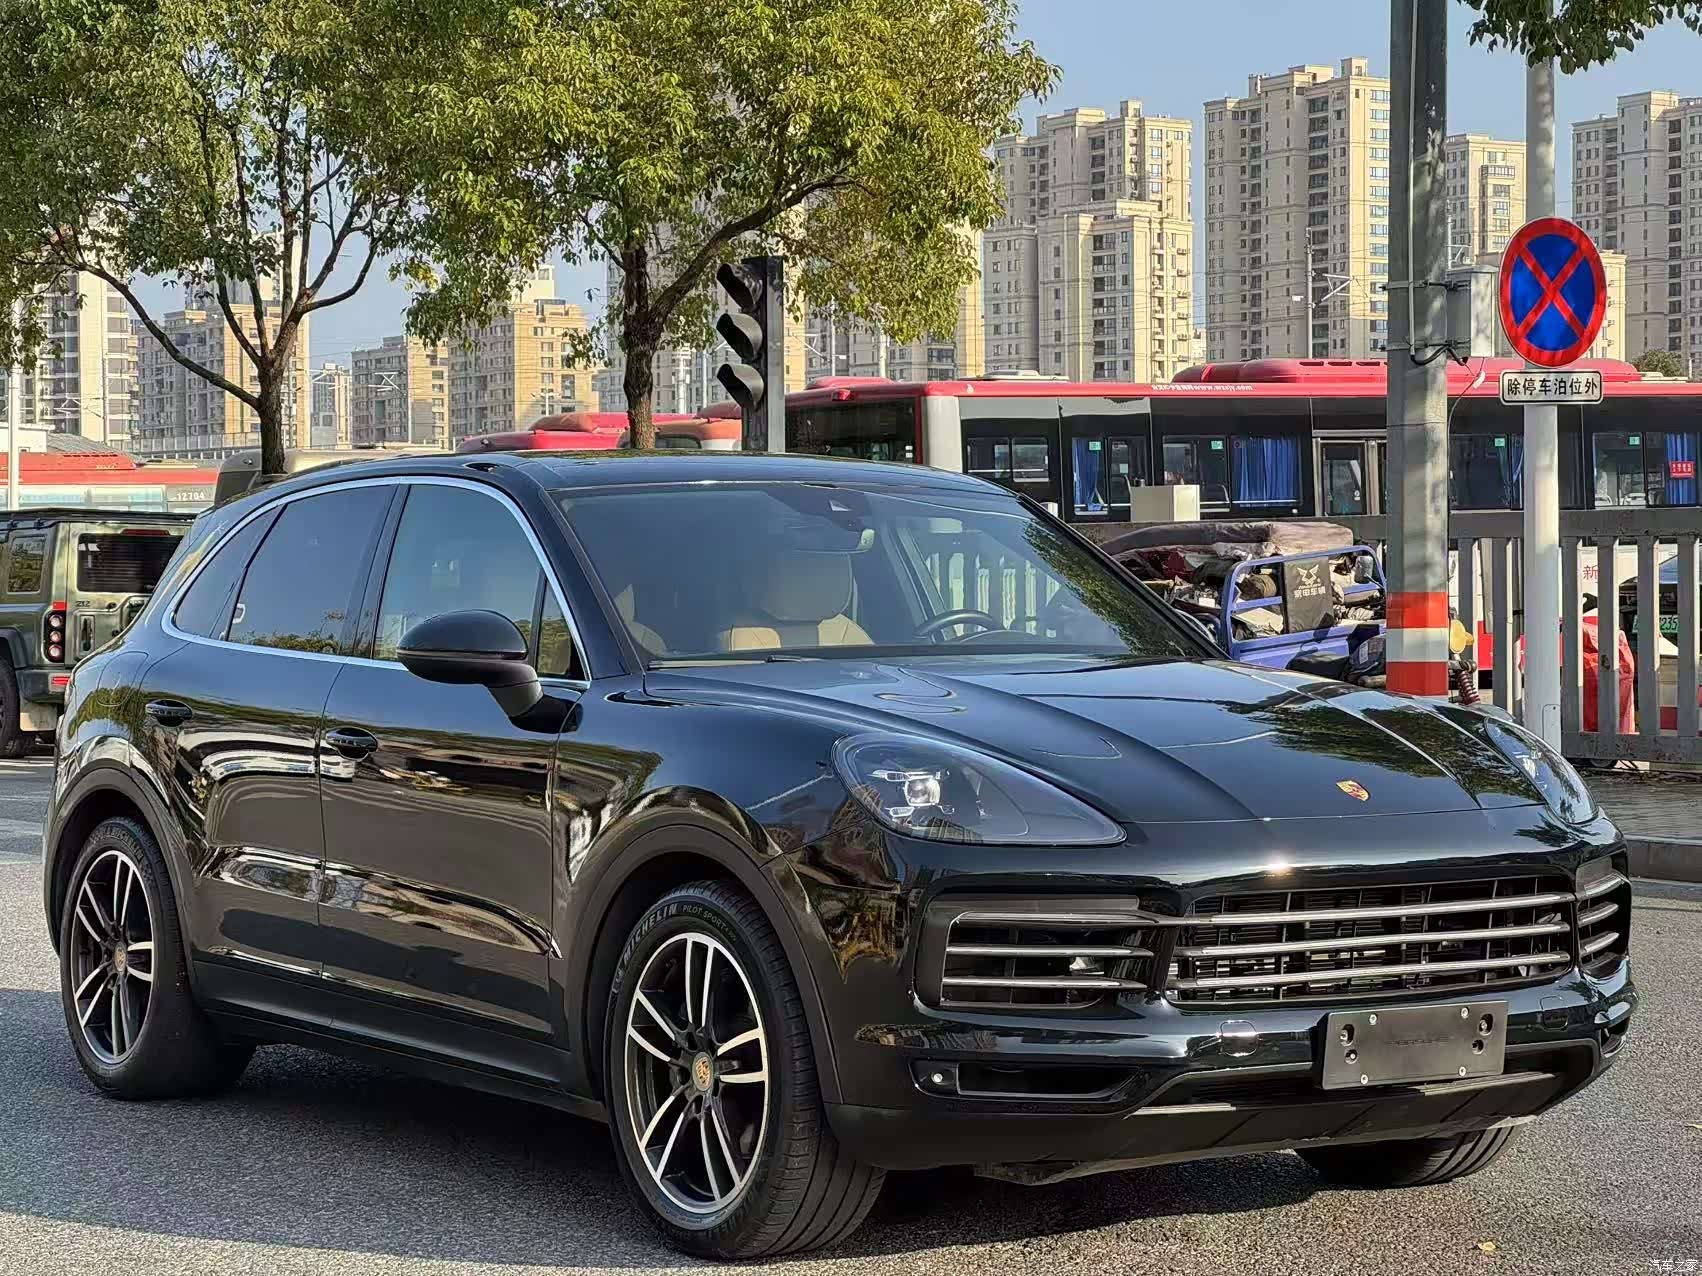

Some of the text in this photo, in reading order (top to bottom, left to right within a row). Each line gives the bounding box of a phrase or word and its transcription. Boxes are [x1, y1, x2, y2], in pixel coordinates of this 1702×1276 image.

[1507, 377, 1598, 396] 除停车泊位外
[1582, 564, 1599, 581] 新
[623, 903, 727, 966] MICHELIN PILOT SPORT
